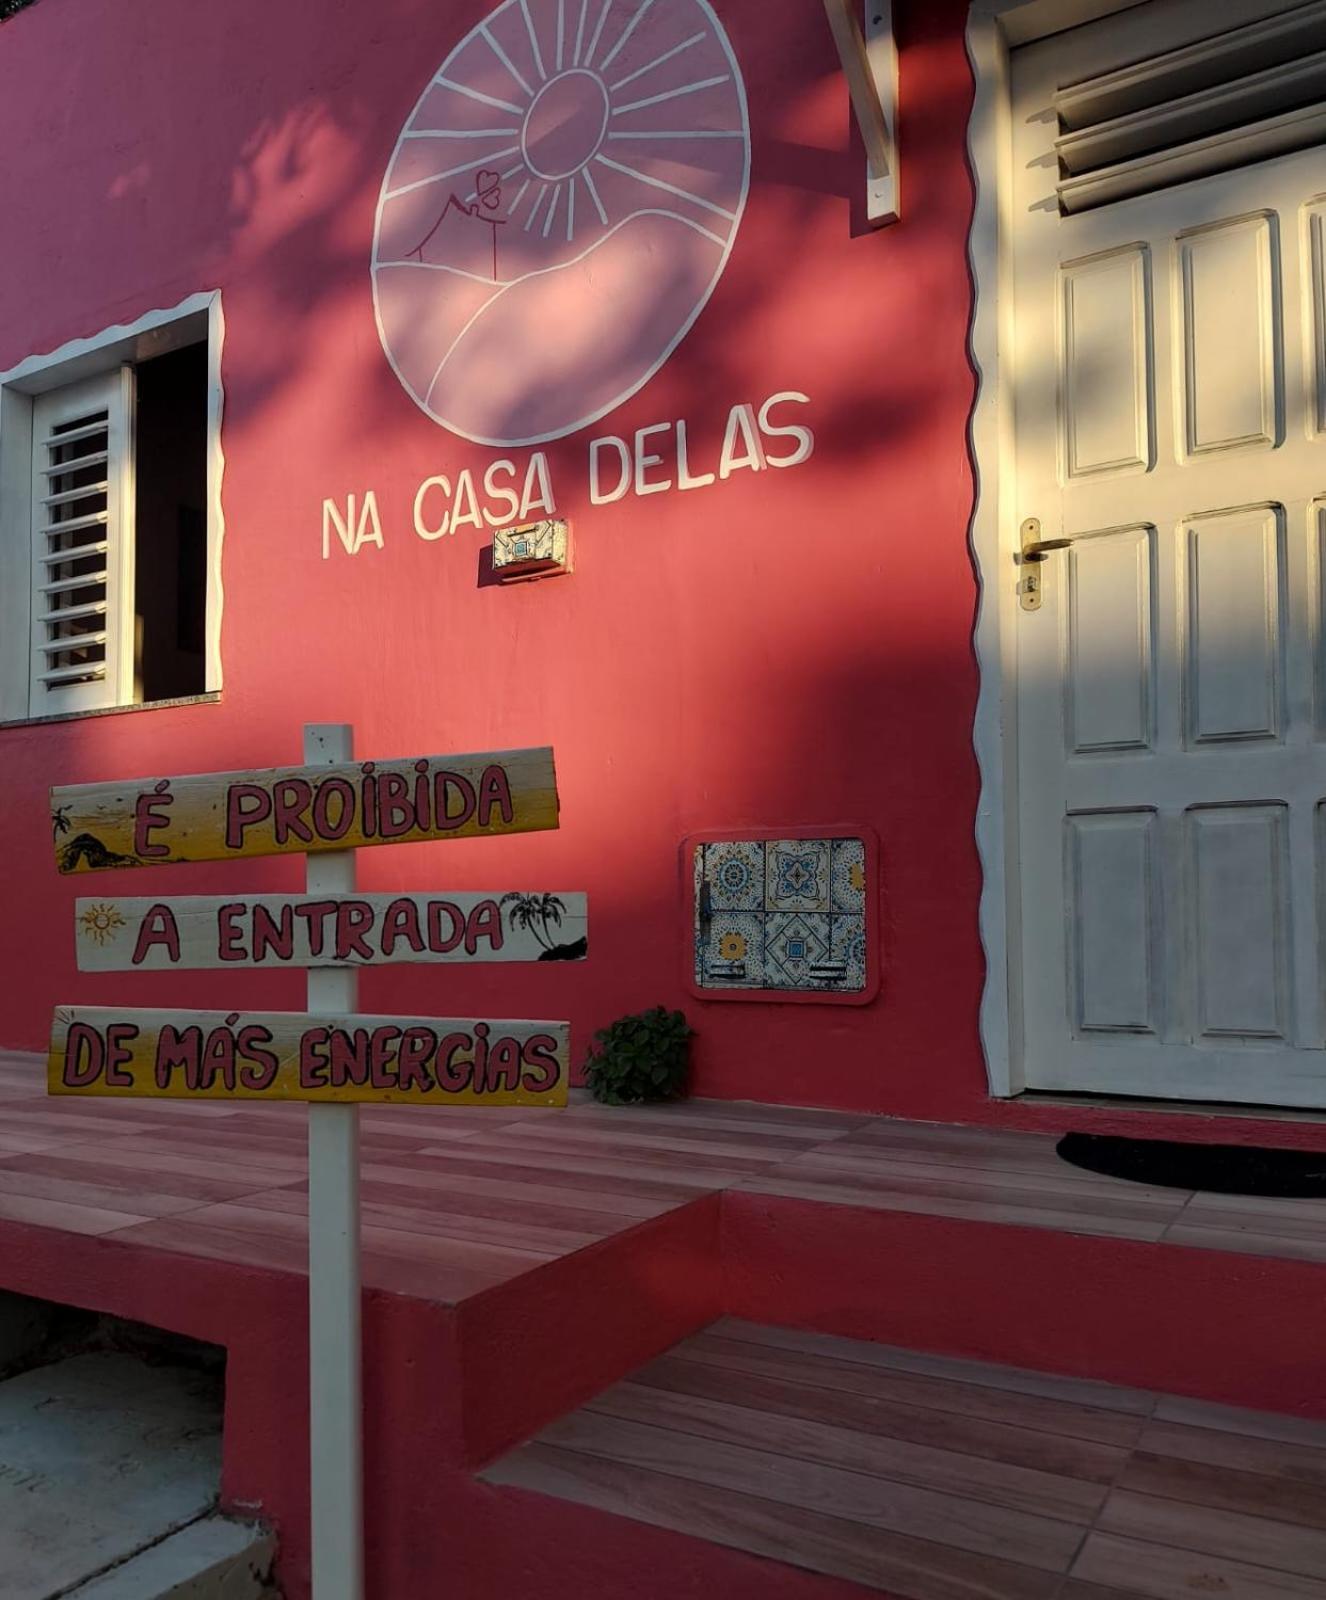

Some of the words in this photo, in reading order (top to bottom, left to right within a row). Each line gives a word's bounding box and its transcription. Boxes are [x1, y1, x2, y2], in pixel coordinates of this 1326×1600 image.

[322, 491, 384, 559] NA
[413, 452, 556, 541] CASA
[589, 391, 814, 505] DELAS
[134, 779, 173, 857] É
[132, 904, 180, 964] A
[218, 898, 504, 961] ENTRADA
[63, 1023, 139, 1087] DE
[155, 1013, 279, 1090] MÁS
